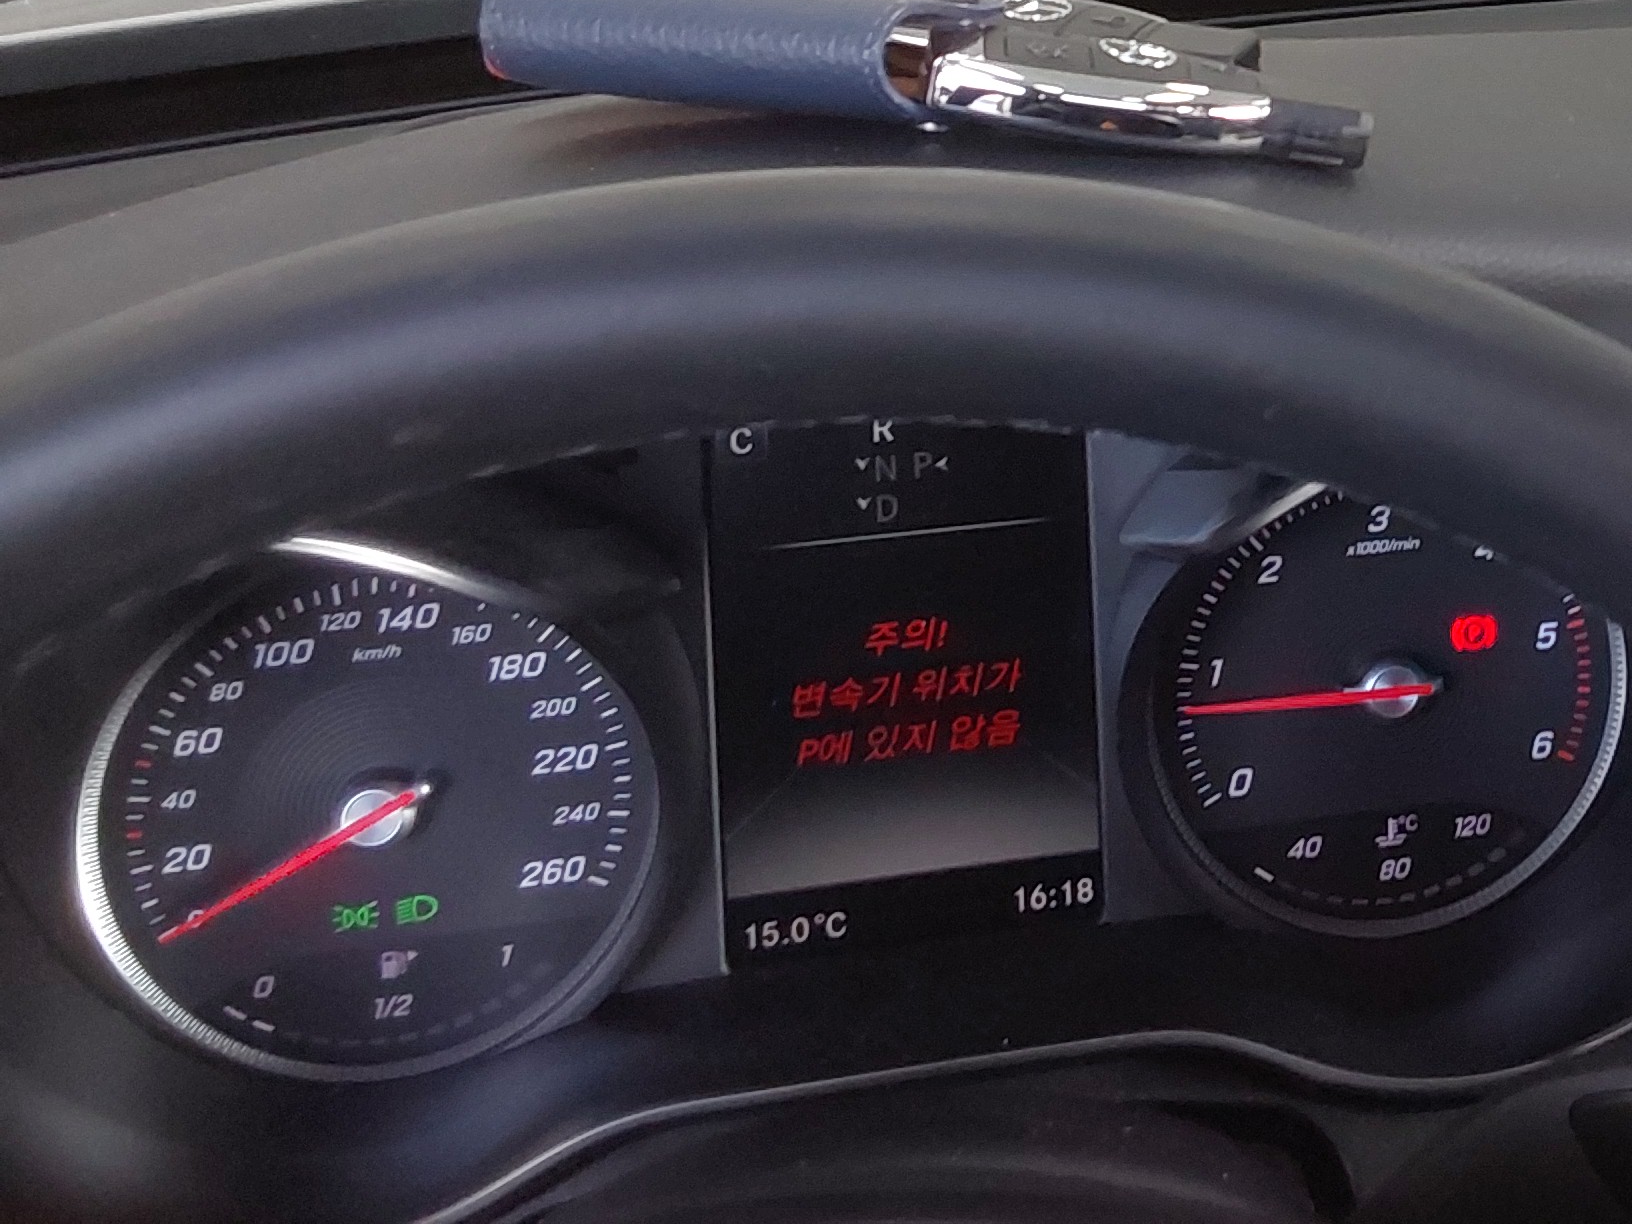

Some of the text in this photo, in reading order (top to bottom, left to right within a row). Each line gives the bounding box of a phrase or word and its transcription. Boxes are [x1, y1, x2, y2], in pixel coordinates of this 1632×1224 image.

[730, 427, 753, 455] C
[875, 451, 933, 482] N P
[877, 494, 899, 523] D
[1367, 505, 1391, 533] 3
[1257, 555, 1283, 584] 2
[320, 610, 362, 632] 120
[378, 602, 440, 634] 140
[451, 623, 493, 646] 160
[866, 617, 948, 656] 주의!
[1535, 621, 1559, 650] 5
[254, 638, 315, 669] 100
[351, 644, 402, 663] km/h
[488, 651, 547, 682] 180
[1210, 658, 1224, 687] 1
[208, 680, 244, 703] 80
[793, 657, 1021, 718] 변속기 위치가
[530, 696, 577, 720] 200
[173, 727, 223, 757] 60
[797, 709, 1021, 766] P에 있지 않음
[1531, 730, 1555, 760] 6
[531, 743, 599, 776] 220
[1228, 767, 1254, 797] 0
[160, 789, 197, 810] 40
[552, 802, 601, 826] 240
[1454, 813, 1492, 839] 120
[161, 843, 212, 874] 20
[1287, 835, 1323, 859] 40
[519, 855, 586, 889] 260
[1379, 857, 1412, 881] 80
[1014, 877, 1094, 913] 16:18
[745, 911, 847, 950] 15.0°C
[501, 944, 514, 967] 1
[253, 975, 275, 999] 0
[374, 993, 413, 1020] 1/2
